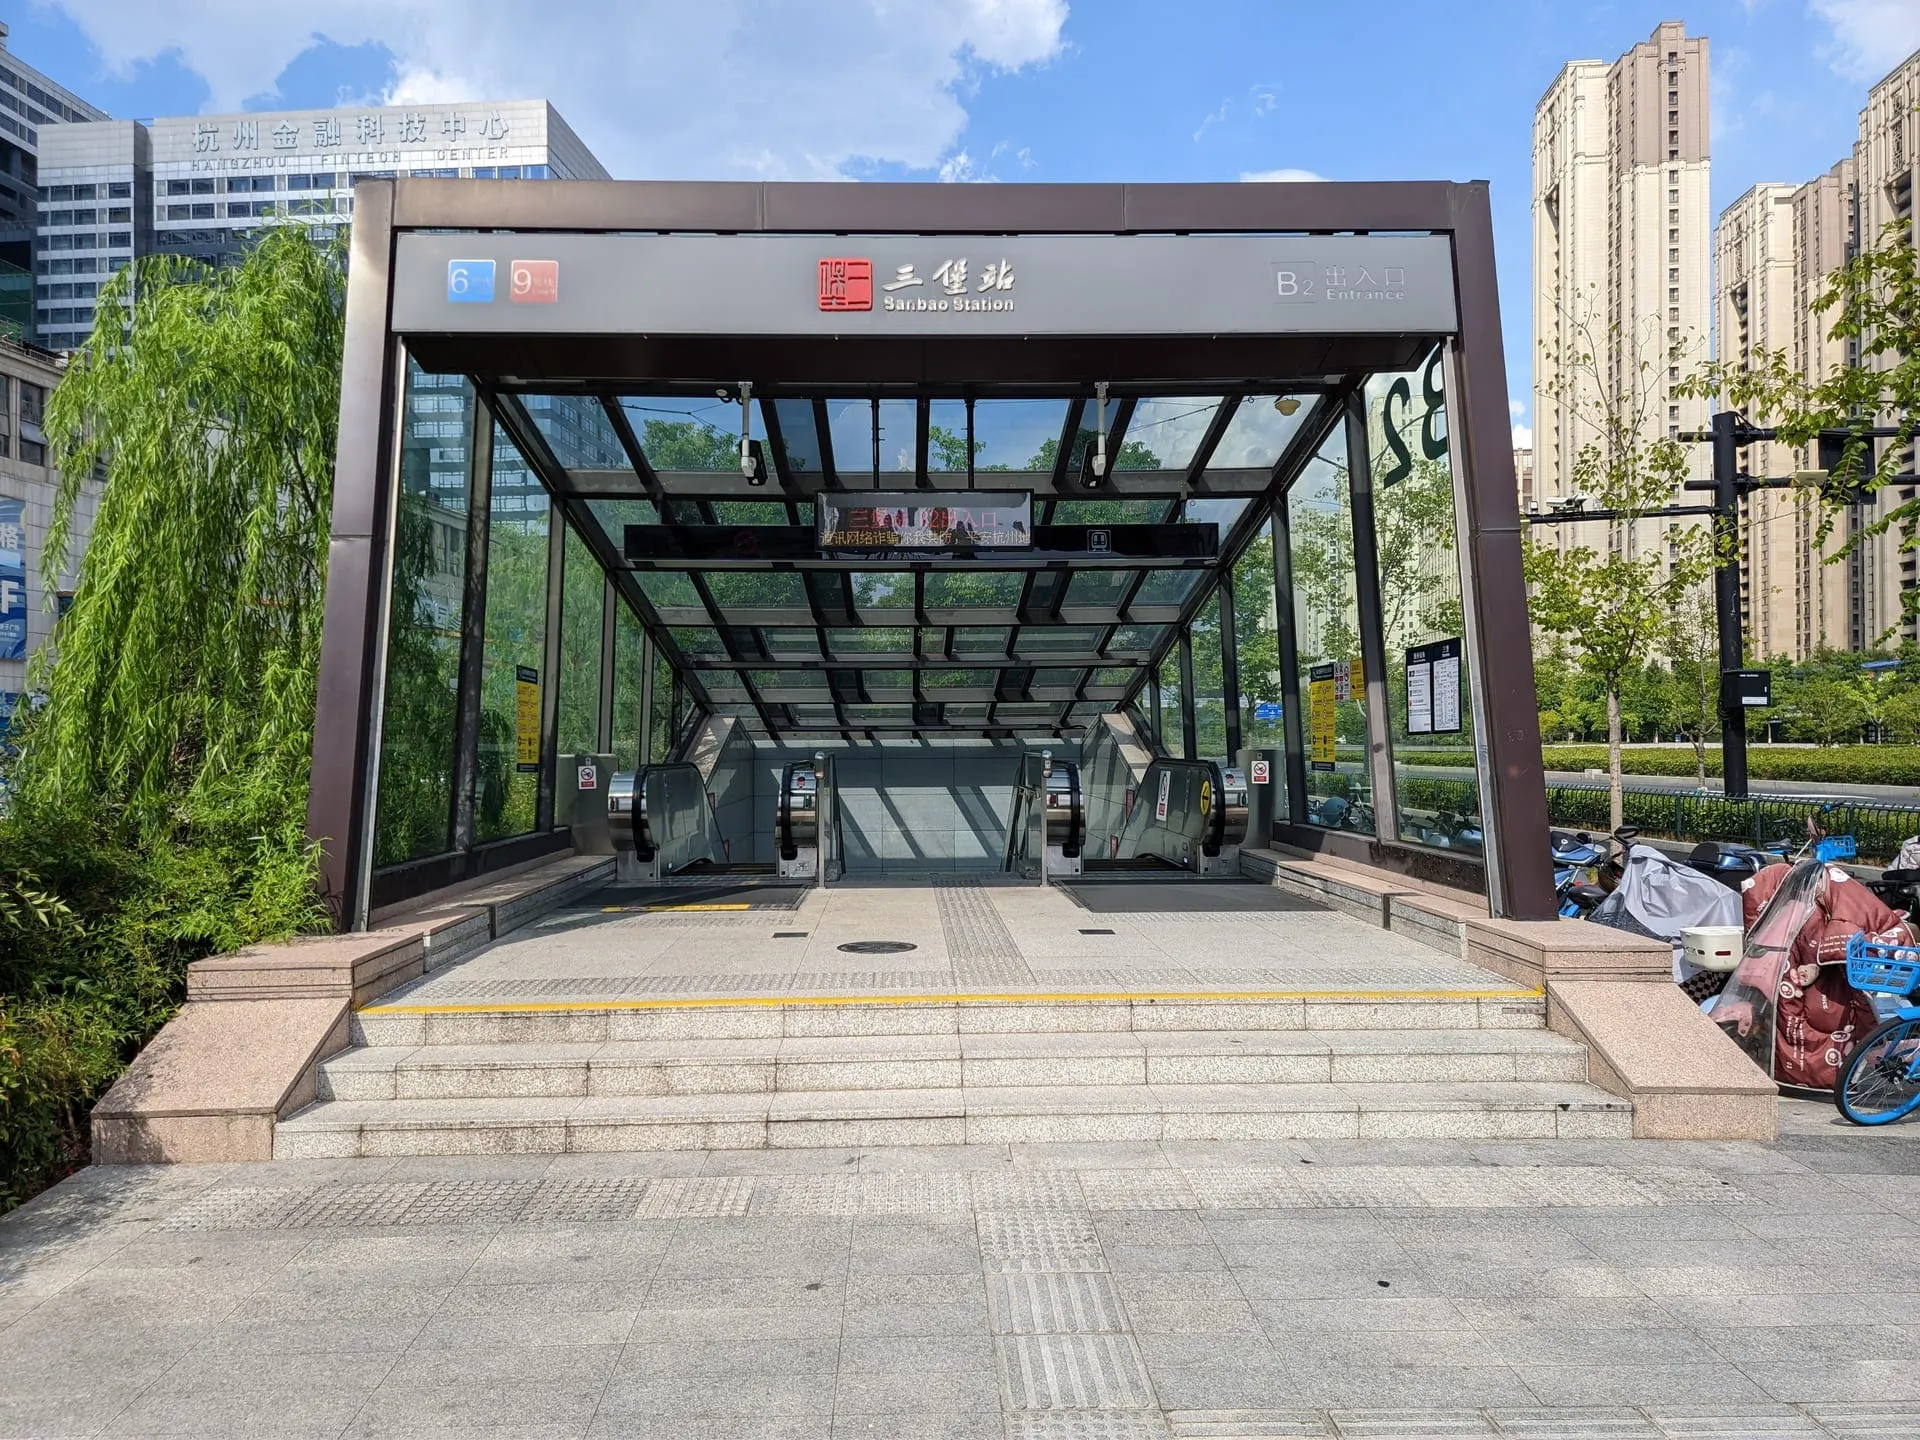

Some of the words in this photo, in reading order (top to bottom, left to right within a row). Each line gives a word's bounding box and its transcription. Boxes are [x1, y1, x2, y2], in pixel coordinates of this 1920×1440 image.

[192, 110, 509, 153] 杭州金融科技中心
[191, 156, 287, 171] HANGZHOU
[321, 151, 401, 166] FINTECH
[437, 146, 509, 161] CENTER
[451, 269, 468, 294] 6
[513, 268, 531, 294] 9
[882, 257, 1015, 296] 三堡站
[1277, 271, 1315, 296] B2
[1325, 265, 1405, 286] 出入口
[884, 296, 949, 312] Sanbao
[953, 296, 1014, 312] Station
[1326, 288, 1405, 300] Entrance
